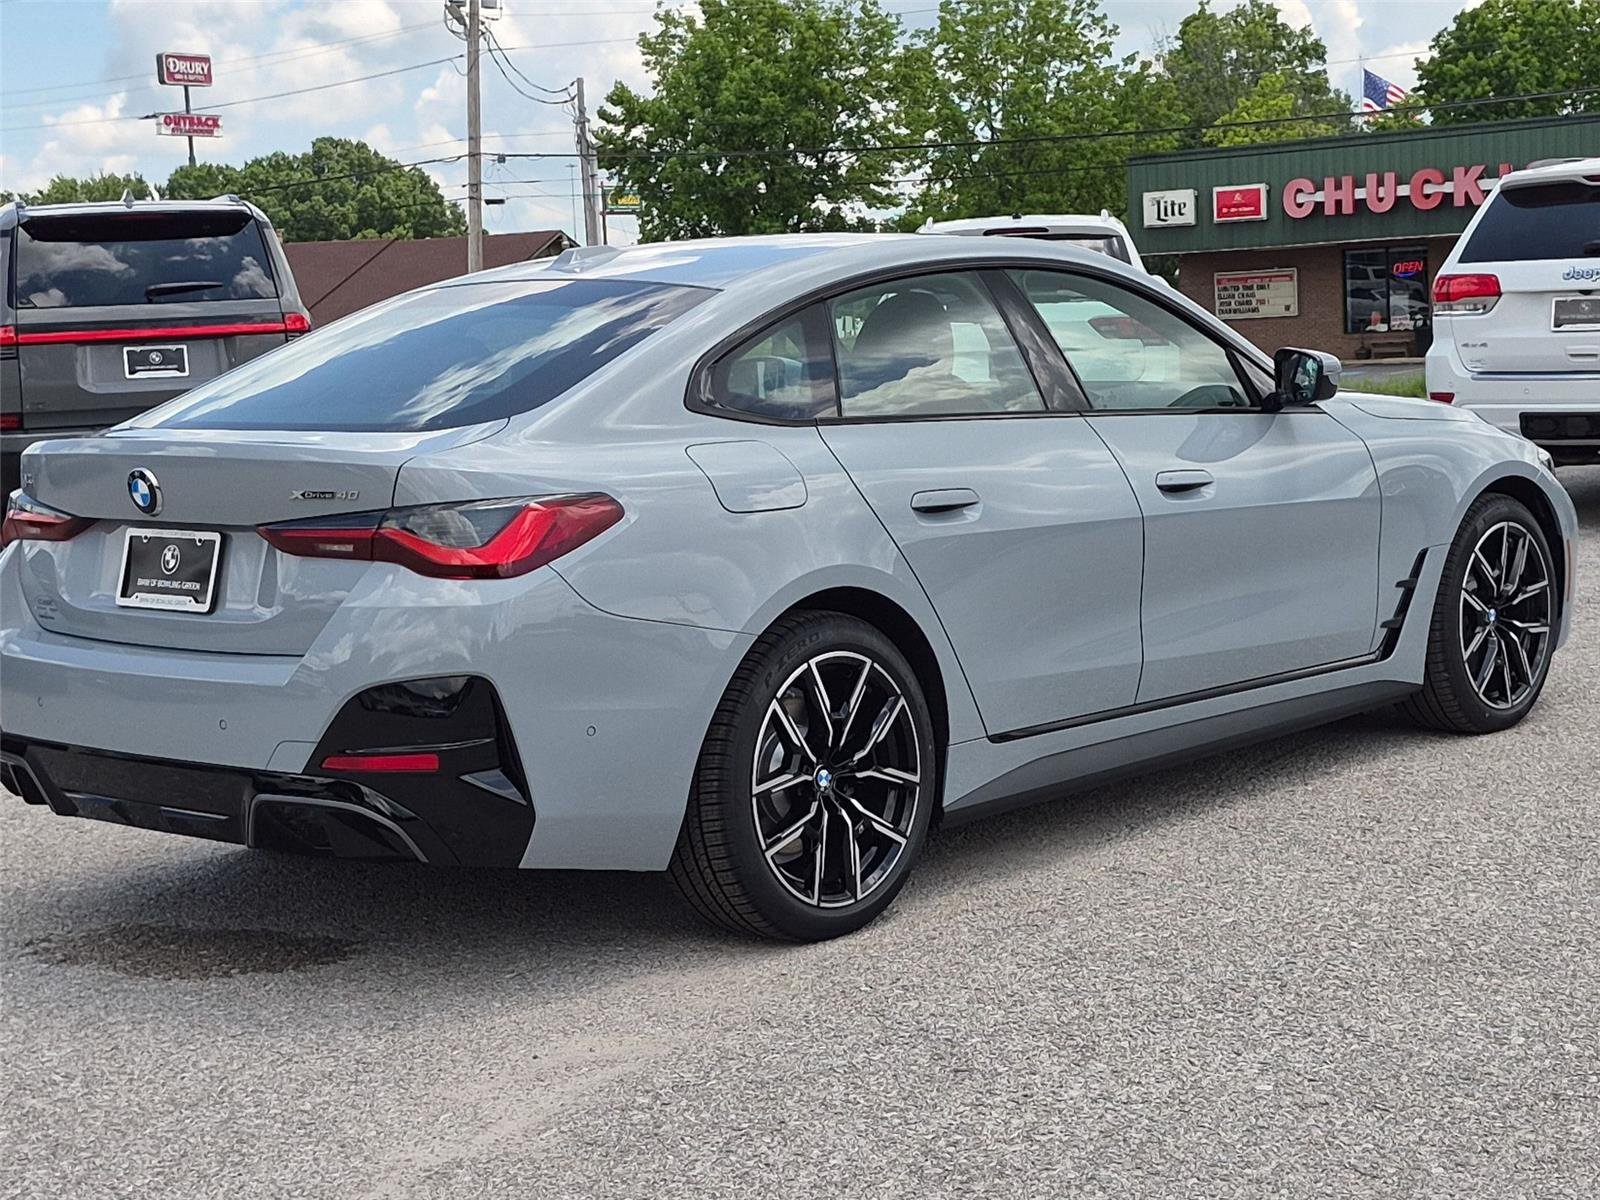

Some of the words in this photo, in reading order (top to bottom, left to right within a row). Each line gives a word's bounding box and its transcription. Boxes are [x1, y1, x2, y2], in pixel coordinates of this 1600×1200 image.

[167, 57, 210, 75] DRURY
[163, 115, 220, 129] OUTBACK
[1154, 199, 1187, 222] Lite
[1393, 260, 1424, 273] OPEN
[1563, 266, 1600, 282] Jeep
[336, 490, 360, 500] 40
[157, 579, 181, 589] BOWLING
[181, 581, 201, 591] GREEN
